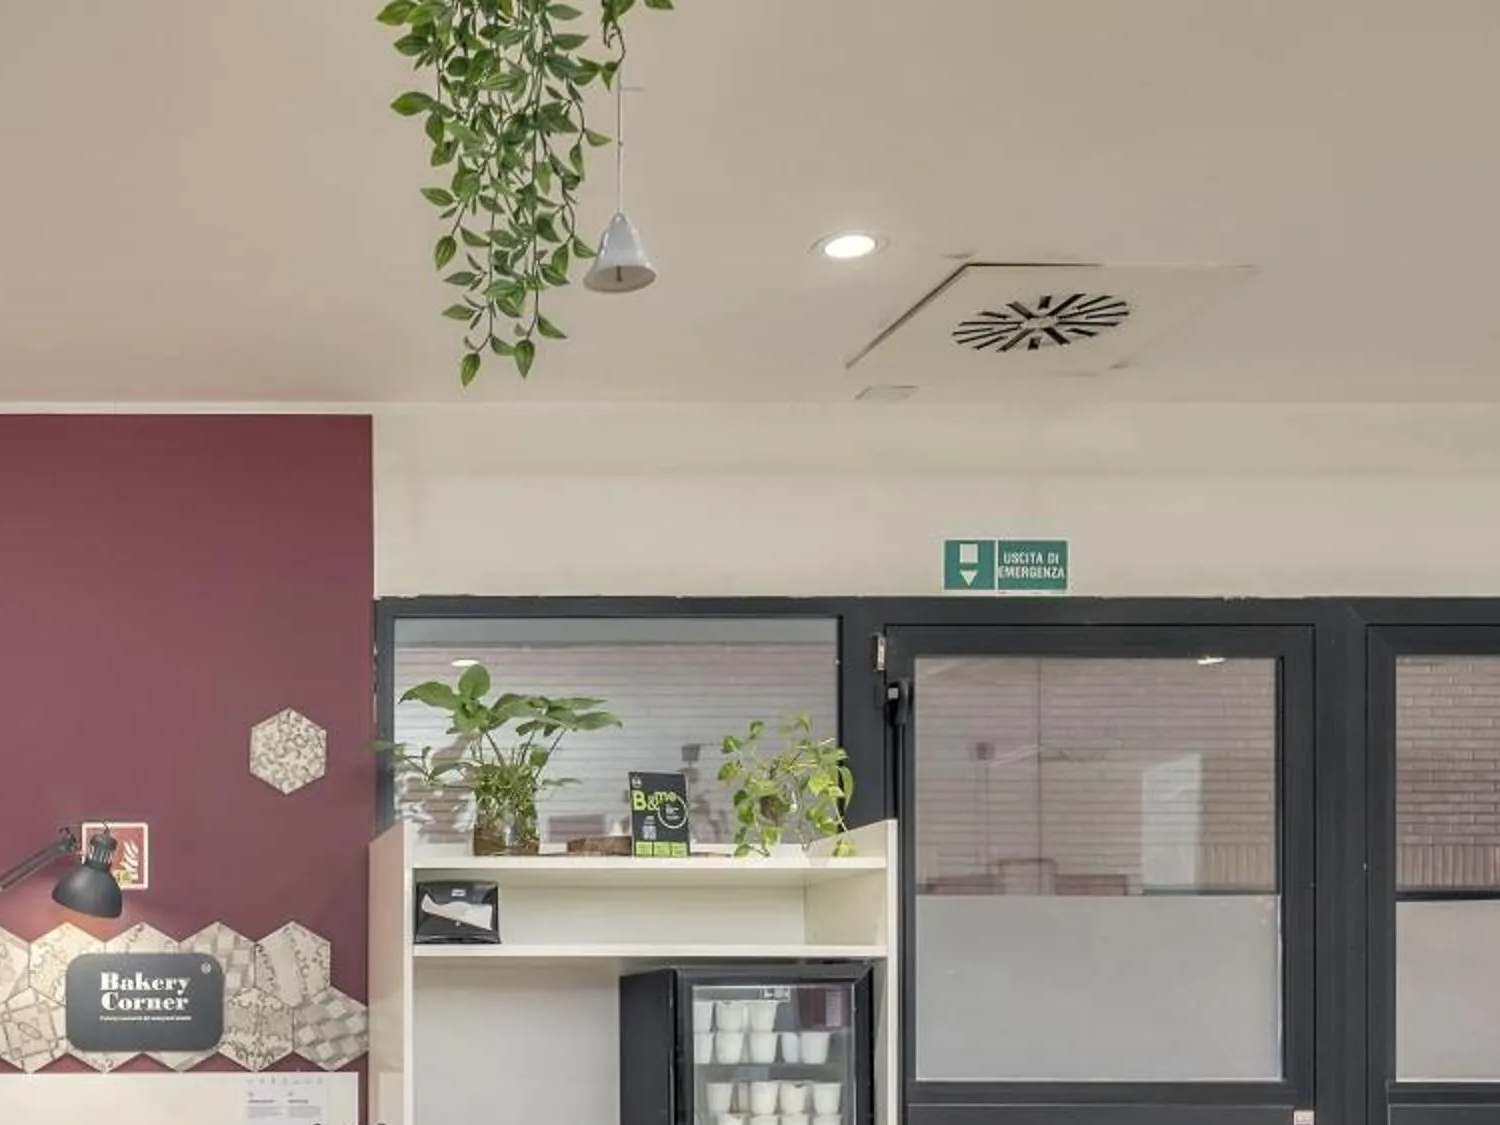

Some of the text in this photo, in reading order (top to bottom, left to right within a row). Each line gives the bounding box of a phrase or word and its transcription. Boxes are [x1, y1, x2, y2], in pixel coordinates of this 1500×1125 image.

[1003, 551, 1060, 565] USCITA DI
[999, 566, 1065, 579] EMERGENZA
[100, 971, 191, 996] Bakery
[101, 991, 189, 1011] Corner
